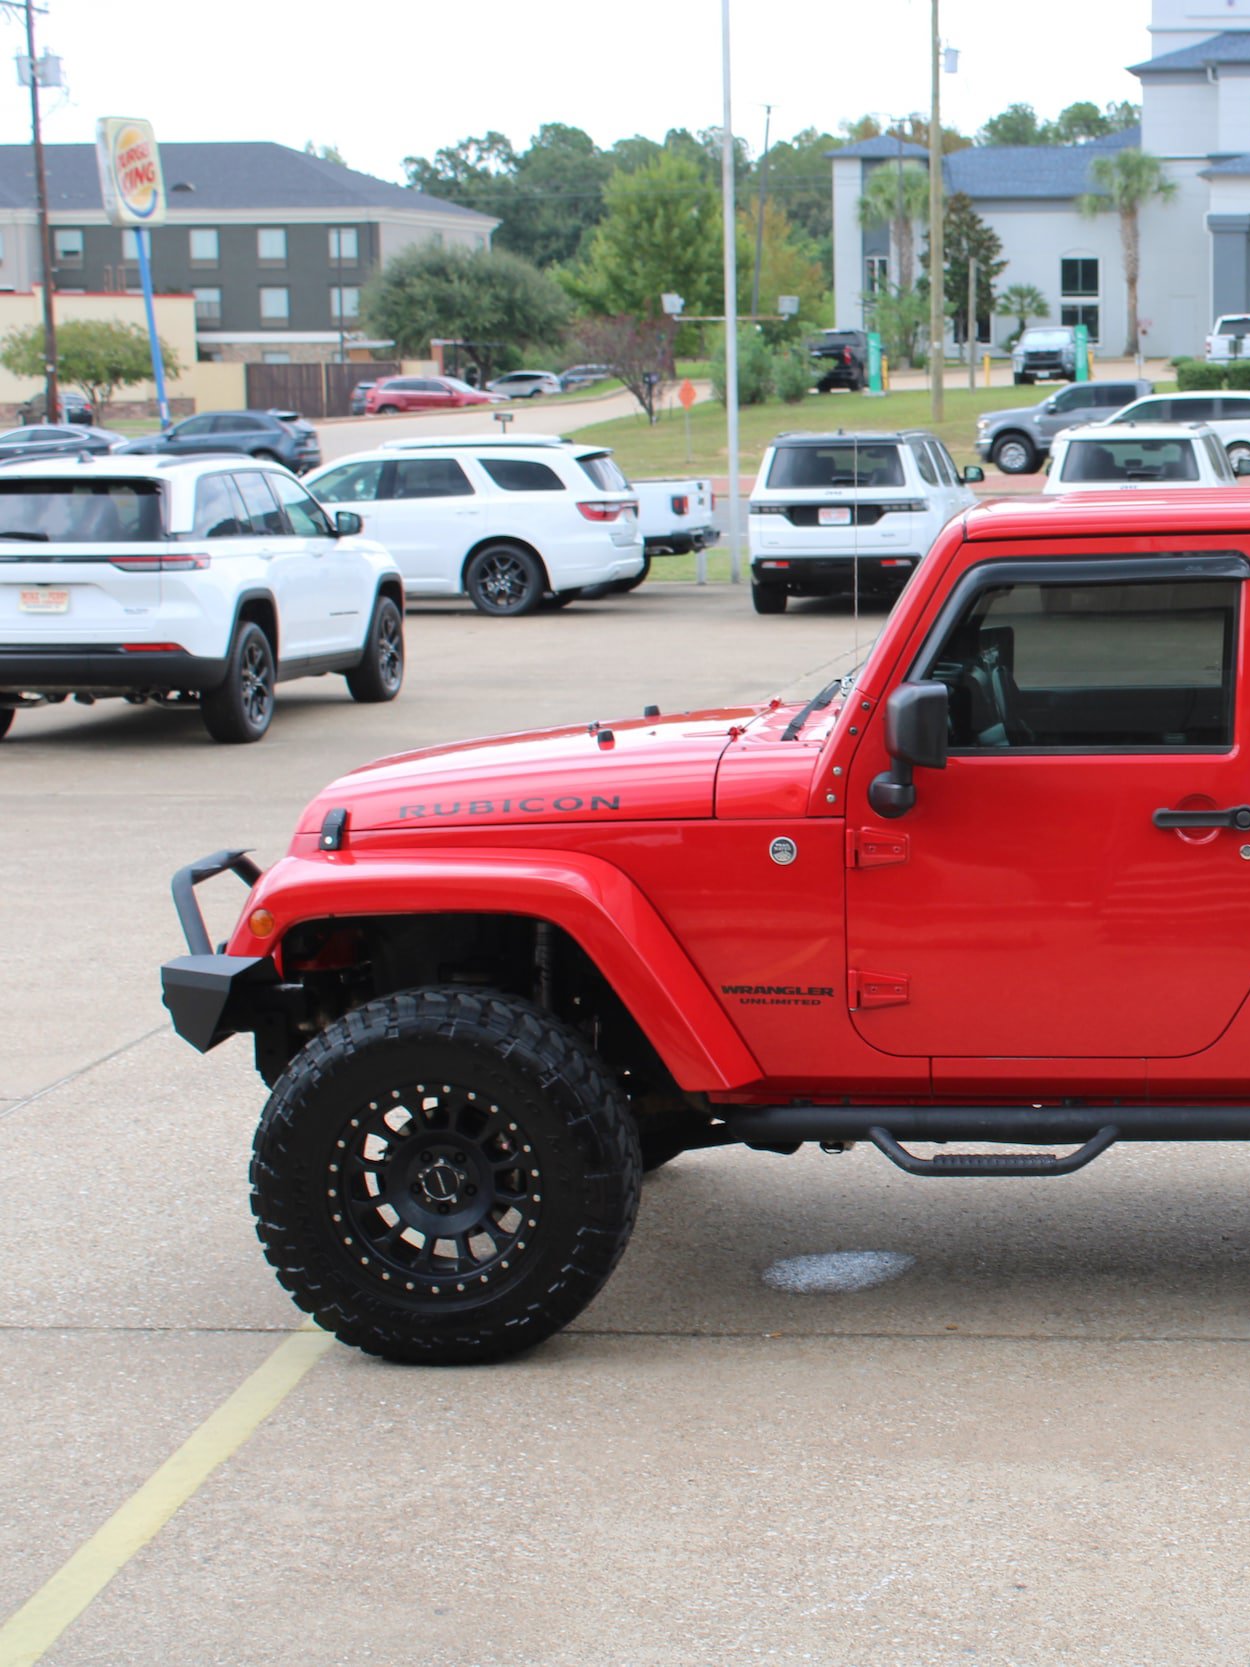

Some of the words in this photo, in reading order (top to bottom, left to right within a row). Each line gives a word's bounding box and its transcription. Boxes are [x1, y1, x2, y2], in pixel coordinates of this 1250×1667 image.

[399, 795, 620, 818] RUBICON
[721, 985, 834, 997] WRANGLER
[740, 997, 822, 1006] UNLIMITED
